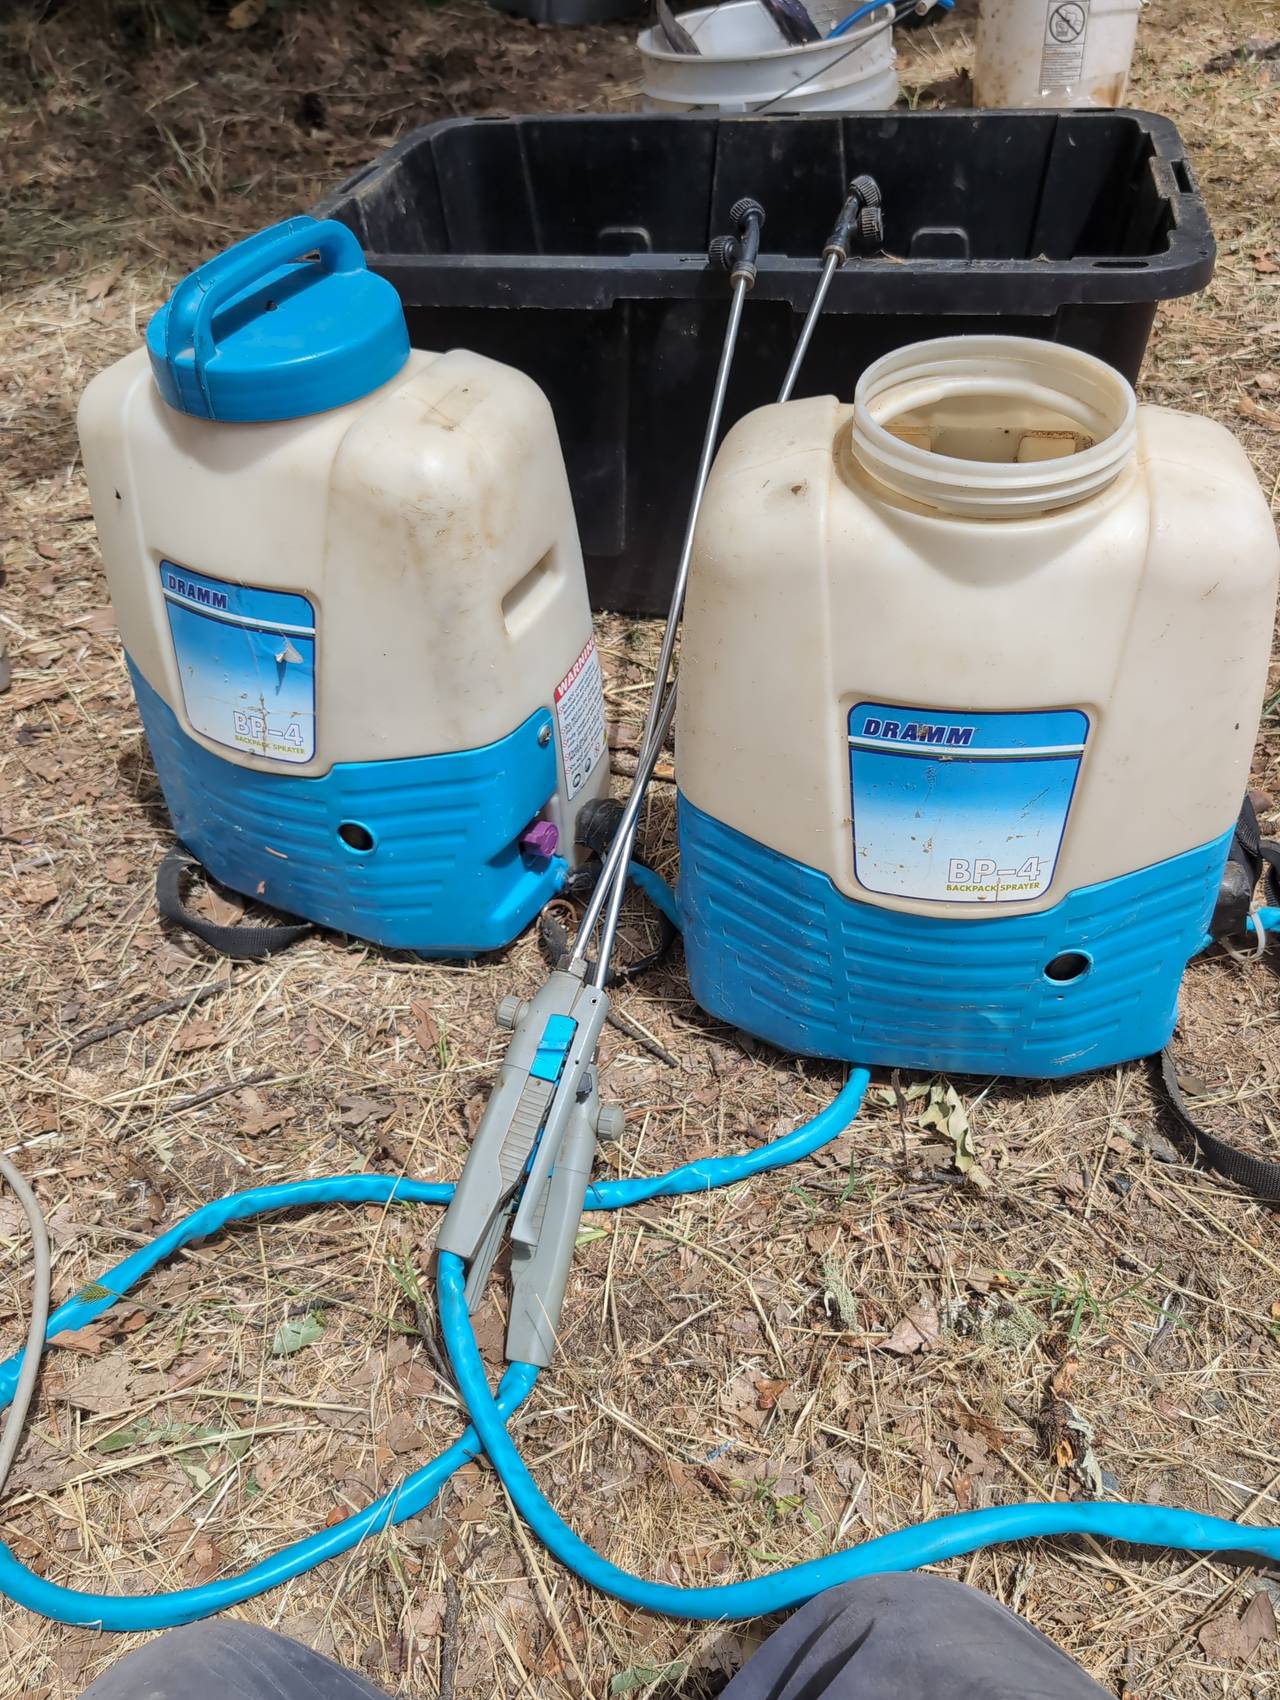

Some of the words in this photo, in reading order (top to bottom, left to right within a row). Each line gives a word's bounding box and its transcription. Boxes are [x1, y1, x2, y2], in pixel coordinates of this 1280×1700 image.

[167, 573, 229, 609] DRAMM
[233, 711, 304, 746] BP-4
[863, 718, 975, 746] DRAMM
[273, 743, 305, 755] SPRAYER
[948, 856, 1041, 883] BP-4
[946, 884, 997, 892] BACKPACK
[1000, 881, 1041, 892] SPRAYER
